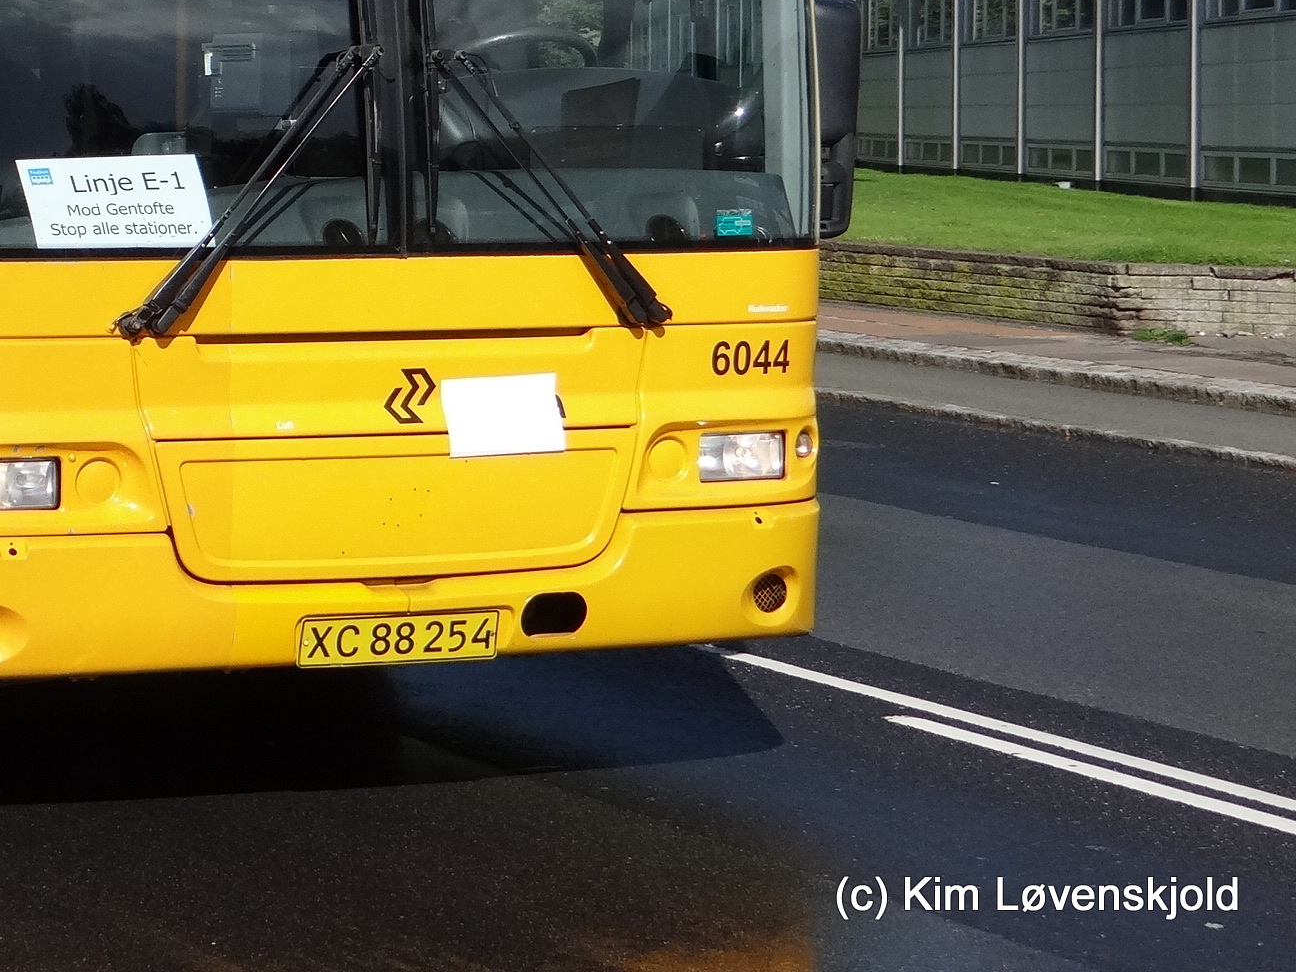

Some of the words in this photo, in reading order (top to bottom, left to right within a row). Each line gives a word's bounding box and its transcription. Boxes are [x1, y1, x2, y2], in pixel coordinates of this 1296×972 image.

[70, 173, 134, 195] Linje
[141, 171, 186, 190] E-1
[67, 203, 101, 216] Mod
[106, 201, 175, 216] Gentofte
[50, 223, 87, 238] Stop
[93, 222, 120, 235] alle
[125, 221, 198, 236] stationer.
[711, 339, 790, 376] 6044
[307, 625, 360, 658] XC
[369, 622, 415, 655] 88
[423, 618, 492, 652] 254
